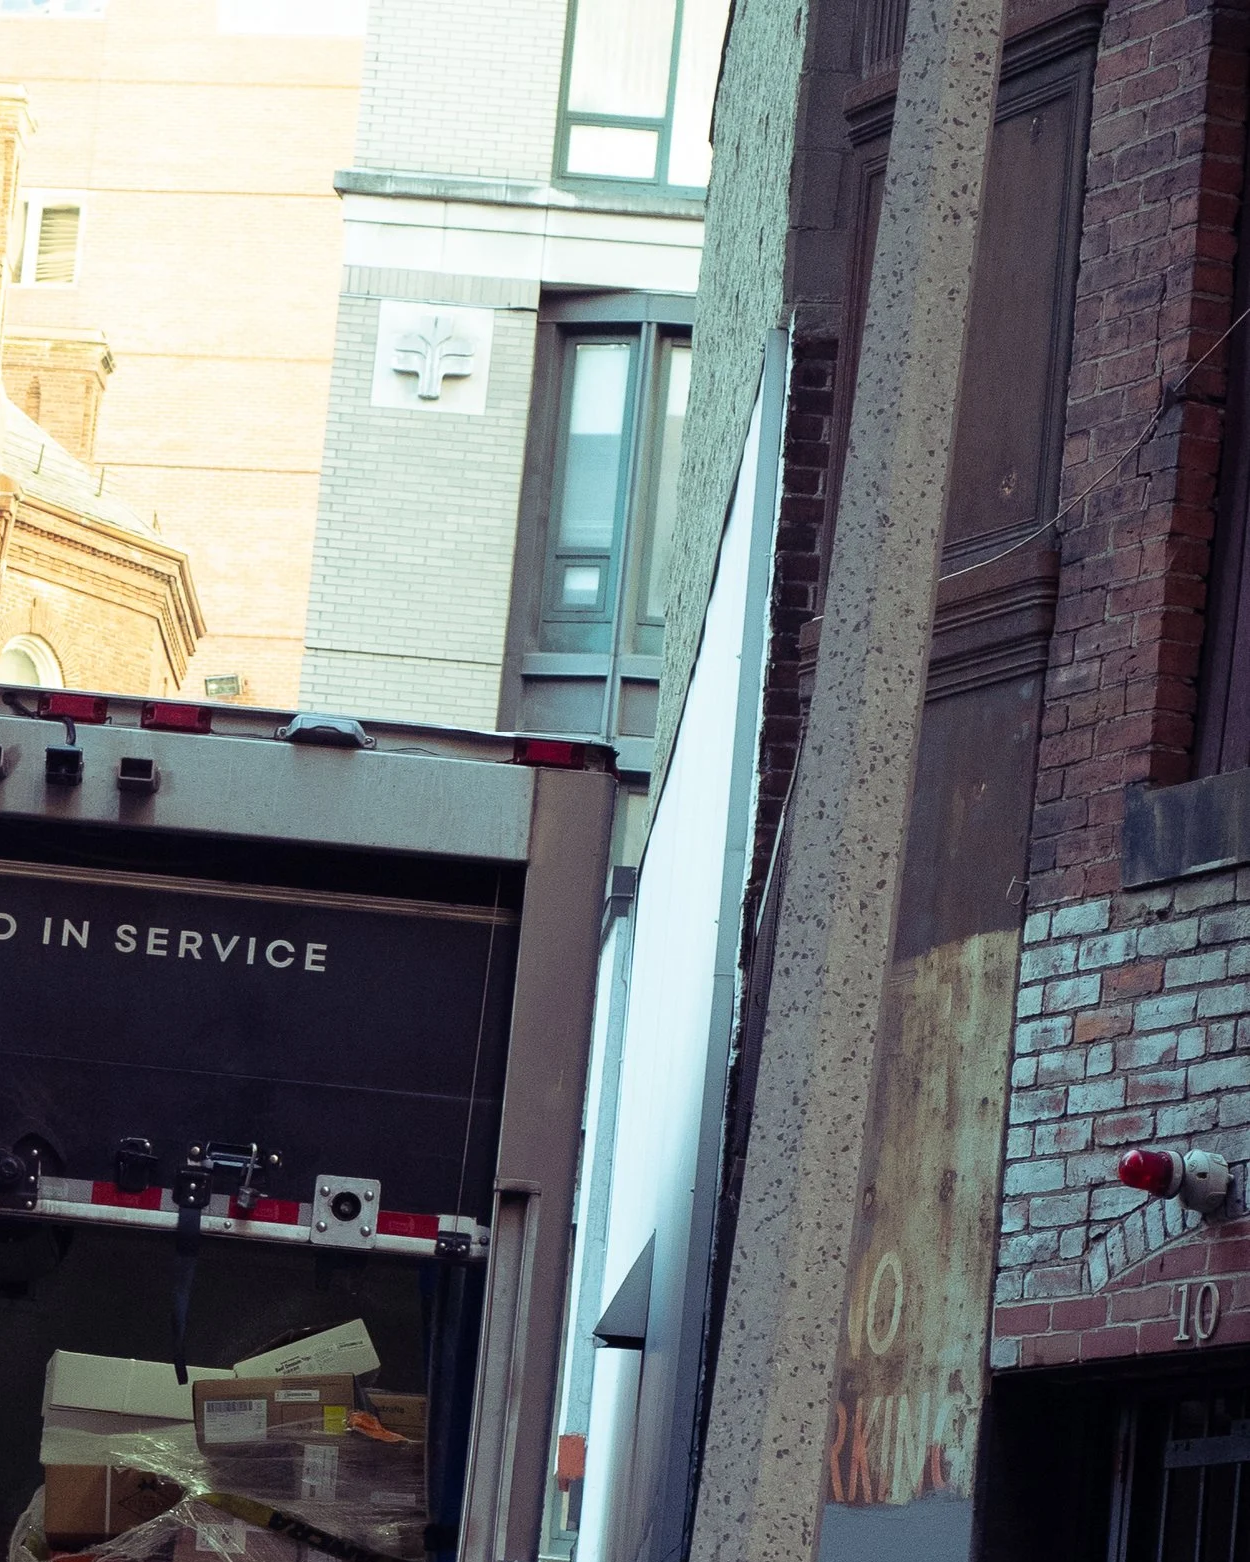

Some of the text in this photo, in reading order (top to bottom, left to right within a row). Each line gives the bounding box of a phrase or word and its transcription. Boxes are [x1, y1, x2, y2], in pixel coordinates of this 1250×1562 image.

[42, 917, 90, 948] IN
[114, 924, 329, 973] SERVICE
[1173, 1282, 1220, 1340] 10
